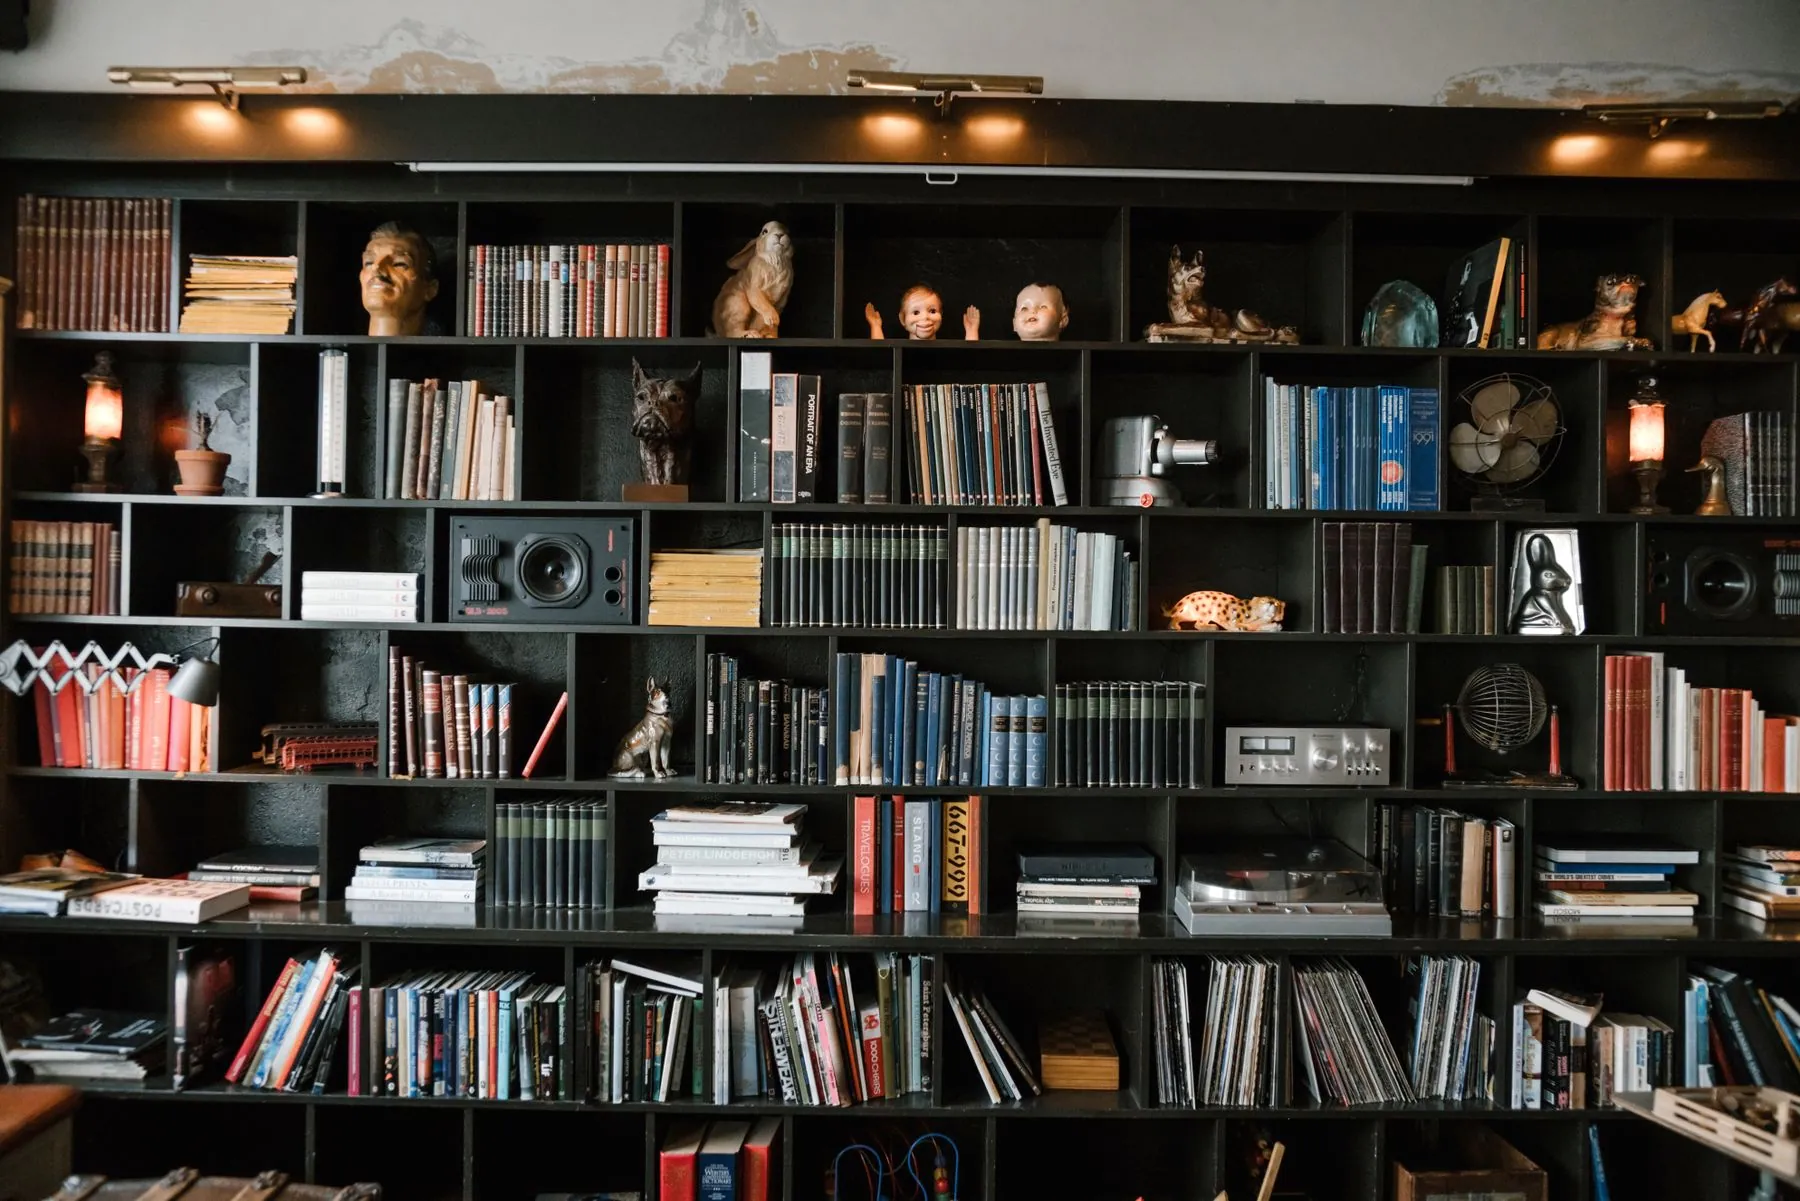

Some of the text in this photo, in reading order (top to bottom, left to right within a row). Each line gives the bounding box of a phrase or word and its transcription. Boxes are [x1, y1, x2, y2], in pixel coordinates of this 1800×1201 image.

[805, 394, 816, 474] PORTRAIT OF AN ERA
[1040, 410, 1060, 480] The Invented Eve
[1413, 431, 1434, 446] 1991
[660, 848, 700, 860] PETER
[782, 848, 790, 861] 116
[860, 818, 870, 894] TRAVELOGUES
[912, 816, 922, 863] SLANG
[948, 806, 966, 898] 667-999
[74, 898, 162, 918] POSTCARDS
[921, 980, 931, 1058] Saint Petersburg
[766, 1002, 796, 1101] STREETWEAR
[870, 1040, 880, 1094] 1000 CHAIRS
